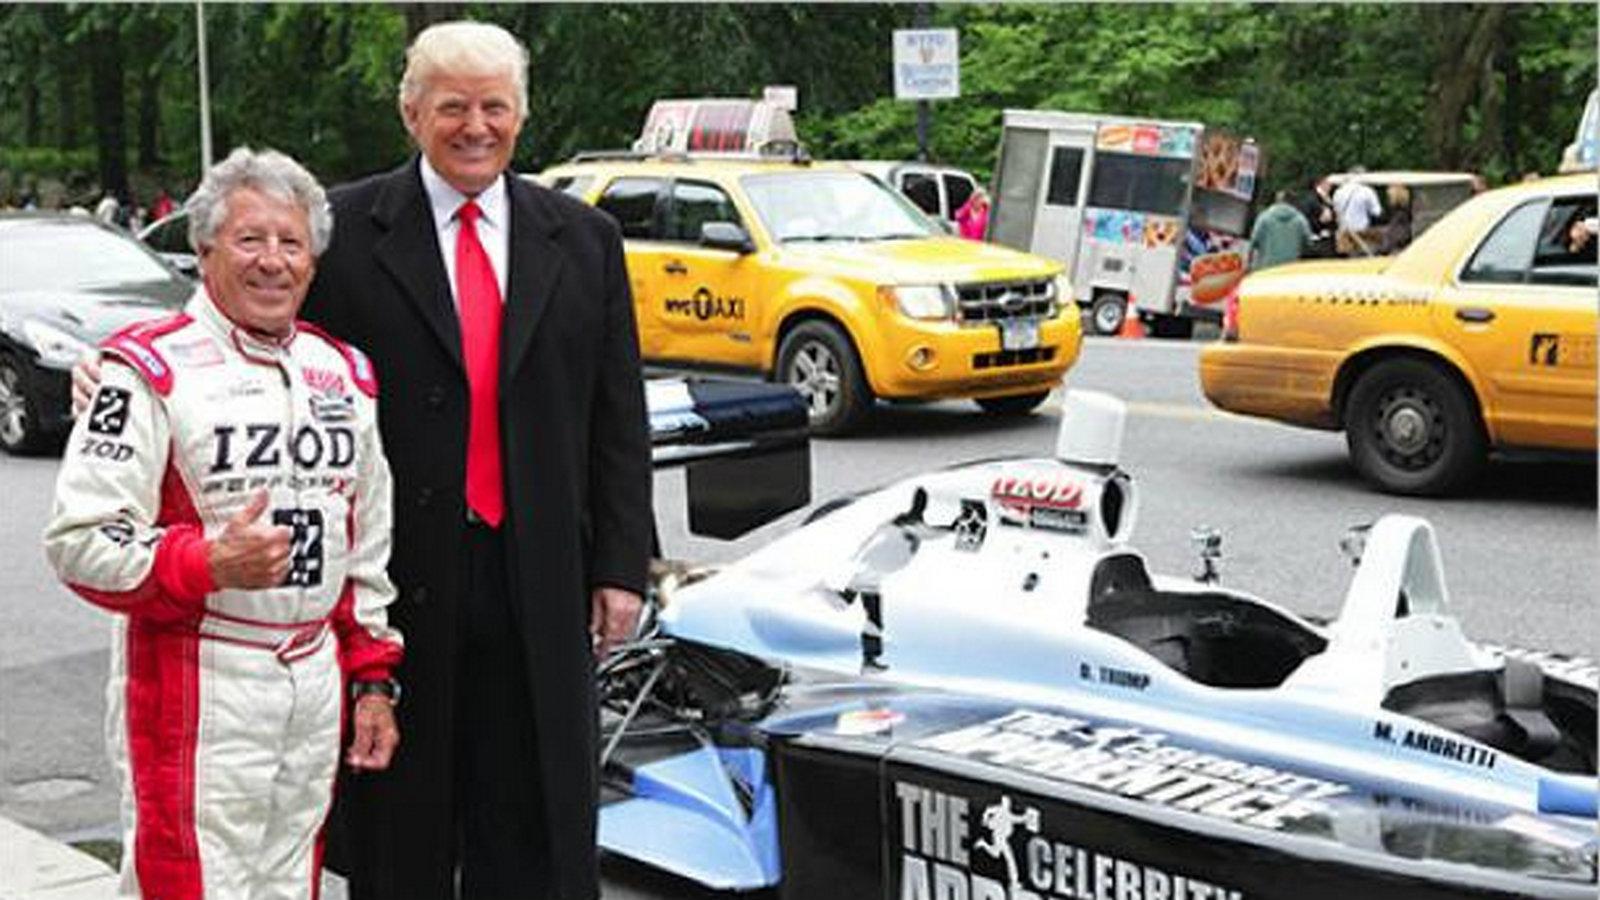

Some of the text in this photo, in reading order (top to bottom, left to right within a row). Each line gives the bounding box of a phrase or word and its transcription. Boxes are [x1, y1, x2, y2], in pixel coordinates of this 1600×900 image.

[209, 424, 355, 474] IZOD
[1373, 720, 1497, 769] M. ANDRETTI
[896, 781, 1244, 900] THE CELEBR
